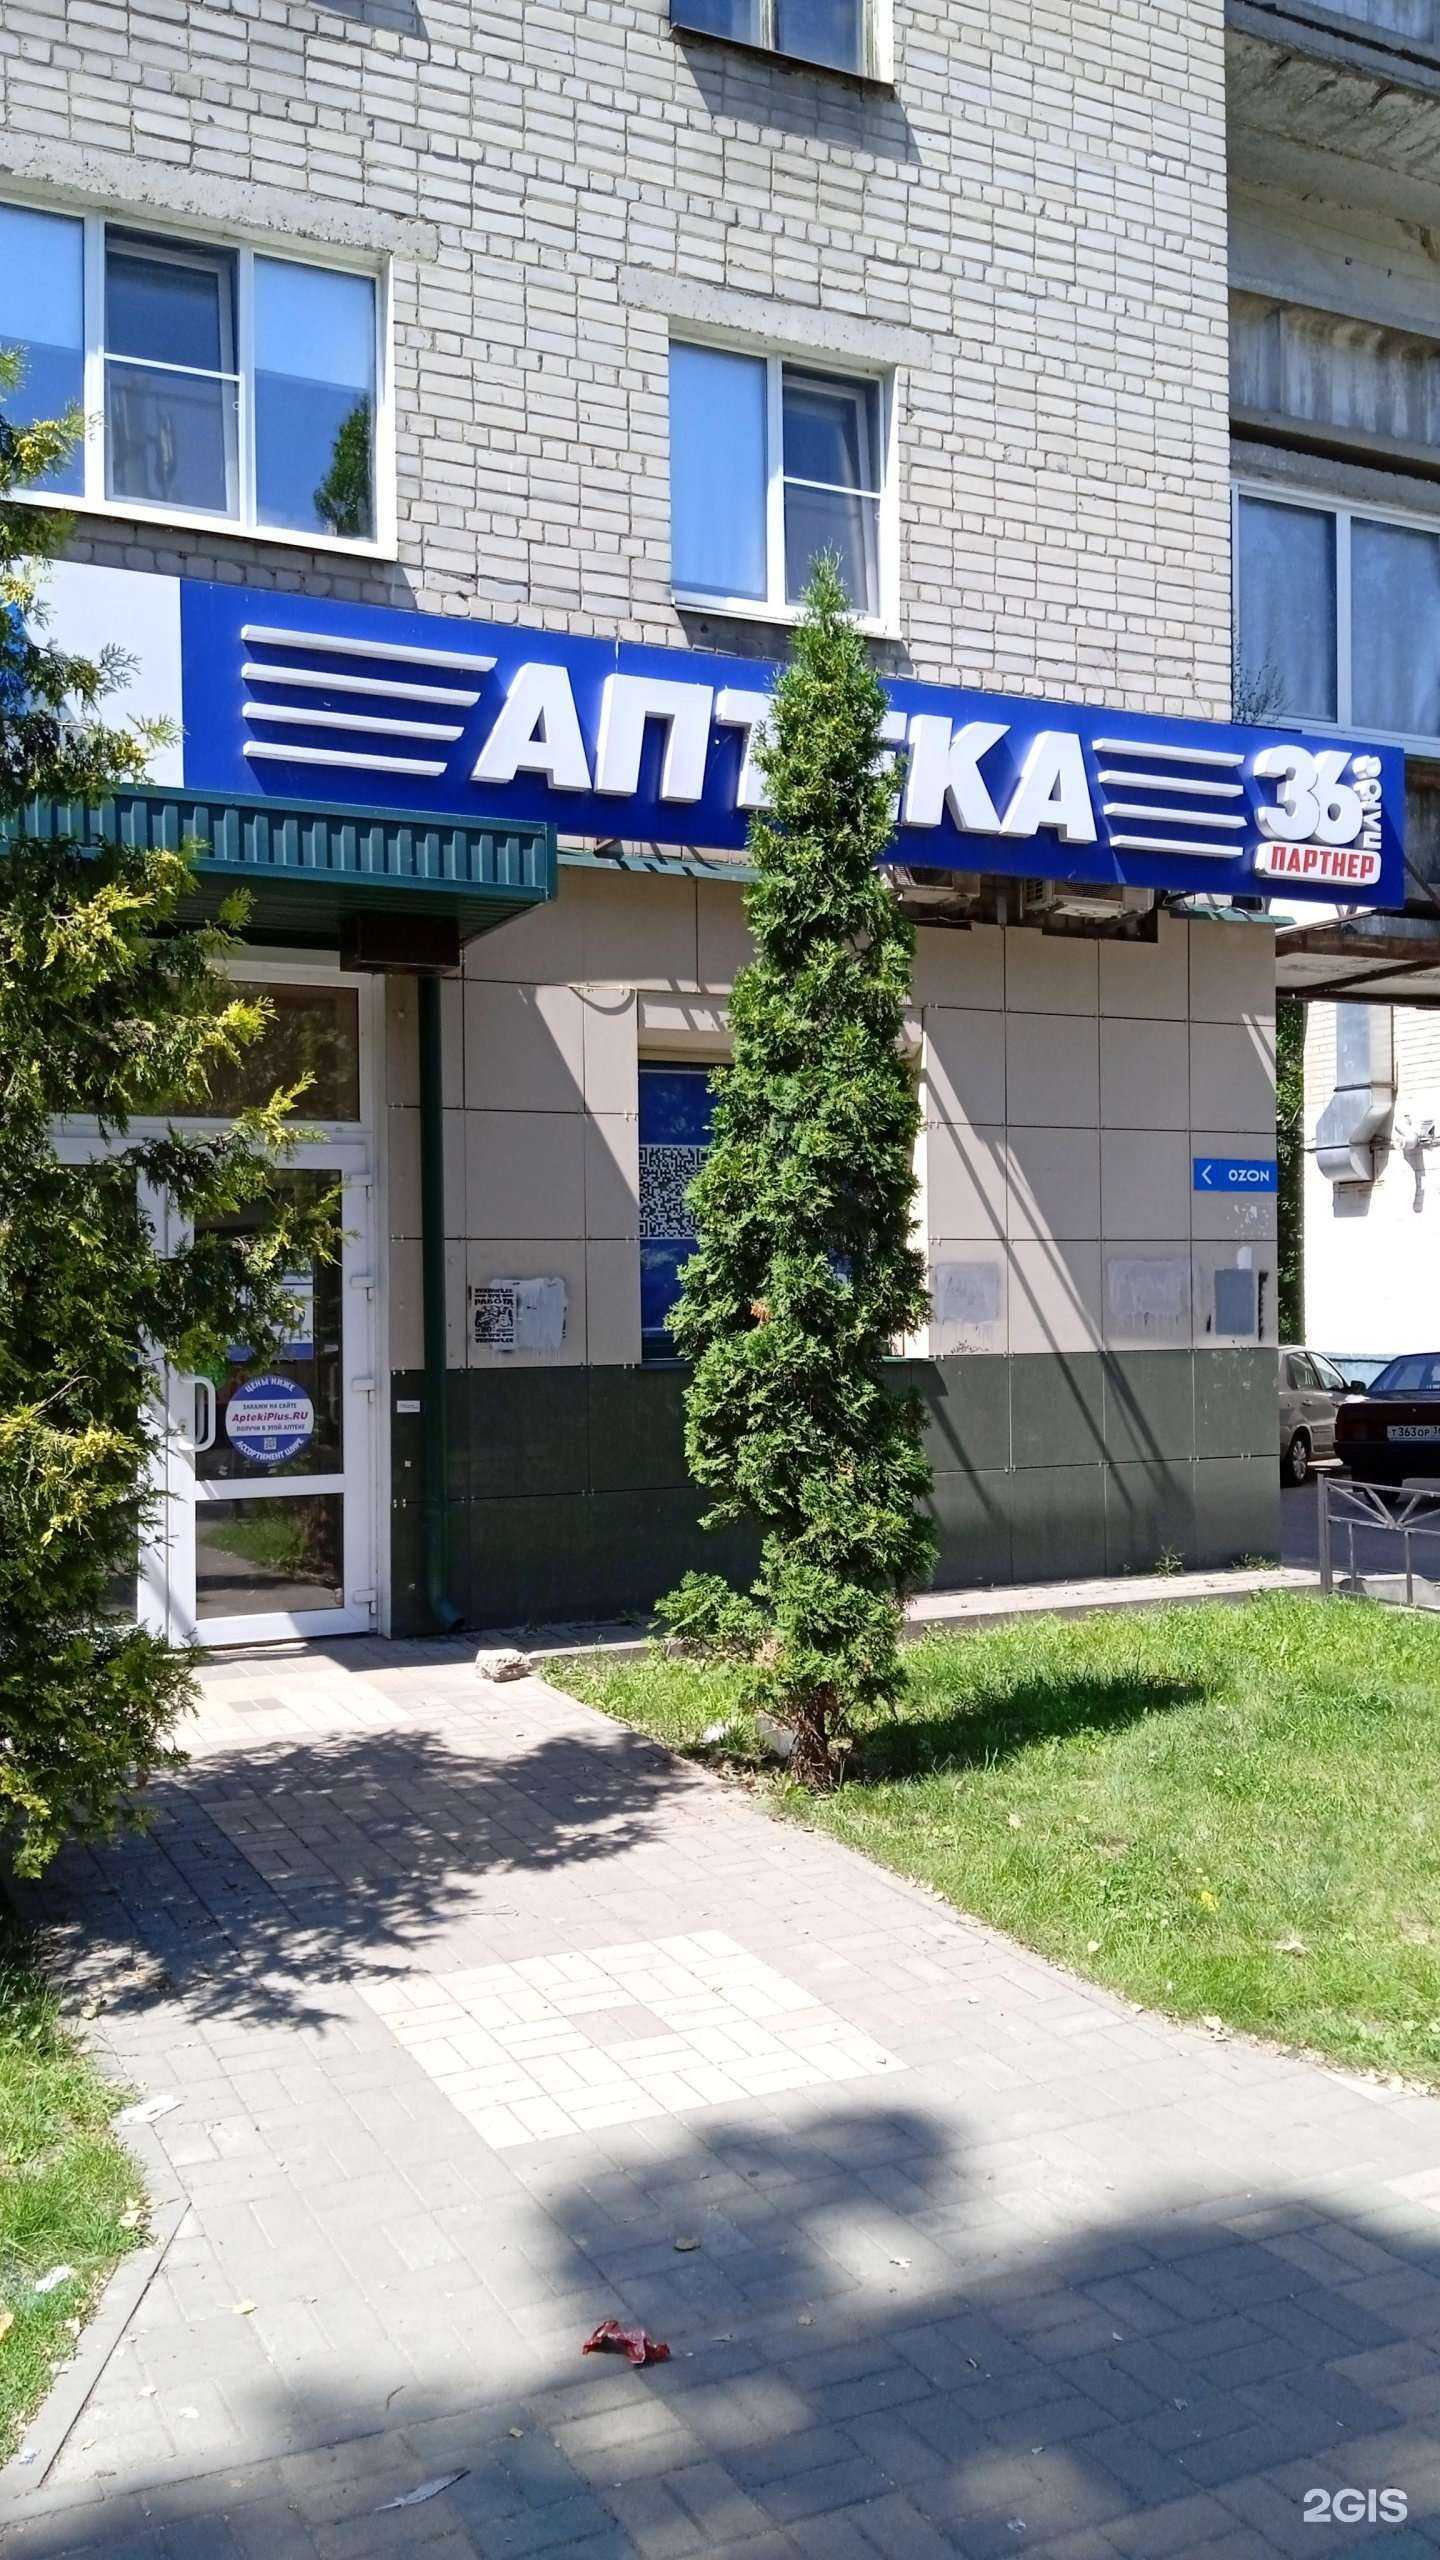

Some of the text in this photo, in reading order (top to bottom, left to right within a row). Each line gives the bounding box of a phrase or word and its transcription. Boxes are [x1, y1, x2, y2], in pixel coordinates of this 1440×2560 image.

[471, 662, 1098, 844] АПТКА
[1253, 744, 1364, 845] 36
[1270, 846, 1375, 879] ПАРТНЕР
[1229, 1169, 1270, 1182] OZON
[232, 1412, 308, 1422] AptekiPlus.RU
[236, 1440, 285, 1461] АССОРТИМЕНТ
